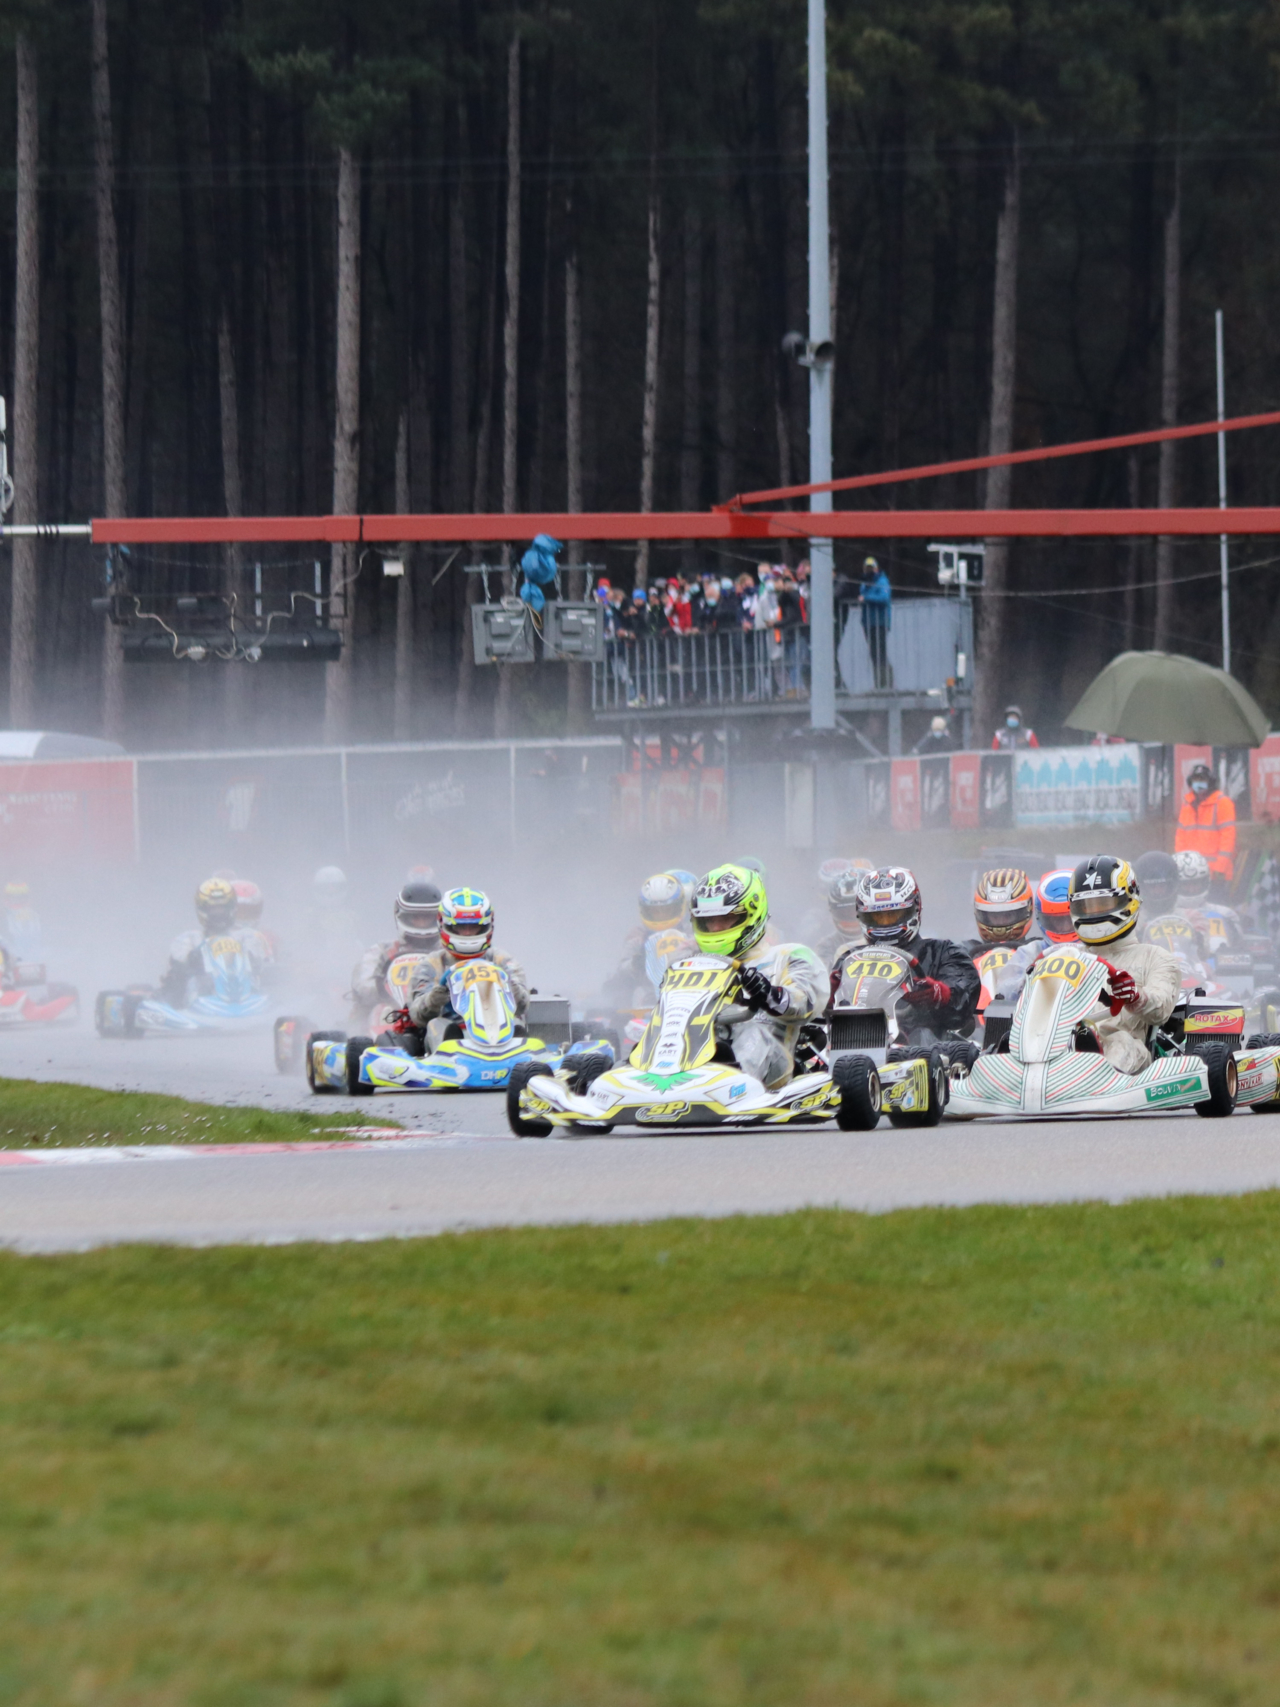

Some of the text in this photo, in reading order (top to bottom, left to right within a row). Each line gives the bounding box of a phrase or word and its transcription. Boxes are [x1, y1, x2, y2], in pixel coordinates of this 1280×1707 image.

[851, 962, 893, 977] 410
[1035, 958, 1081, 981] 400
[667, 972, 720, 989] 401
[889, 1082, 906, 1099] SP
[526, 1099, 550, 1111] SP
[800, 1093, 829, 1108] SP
[647, 1102, 684, 1115] SP
